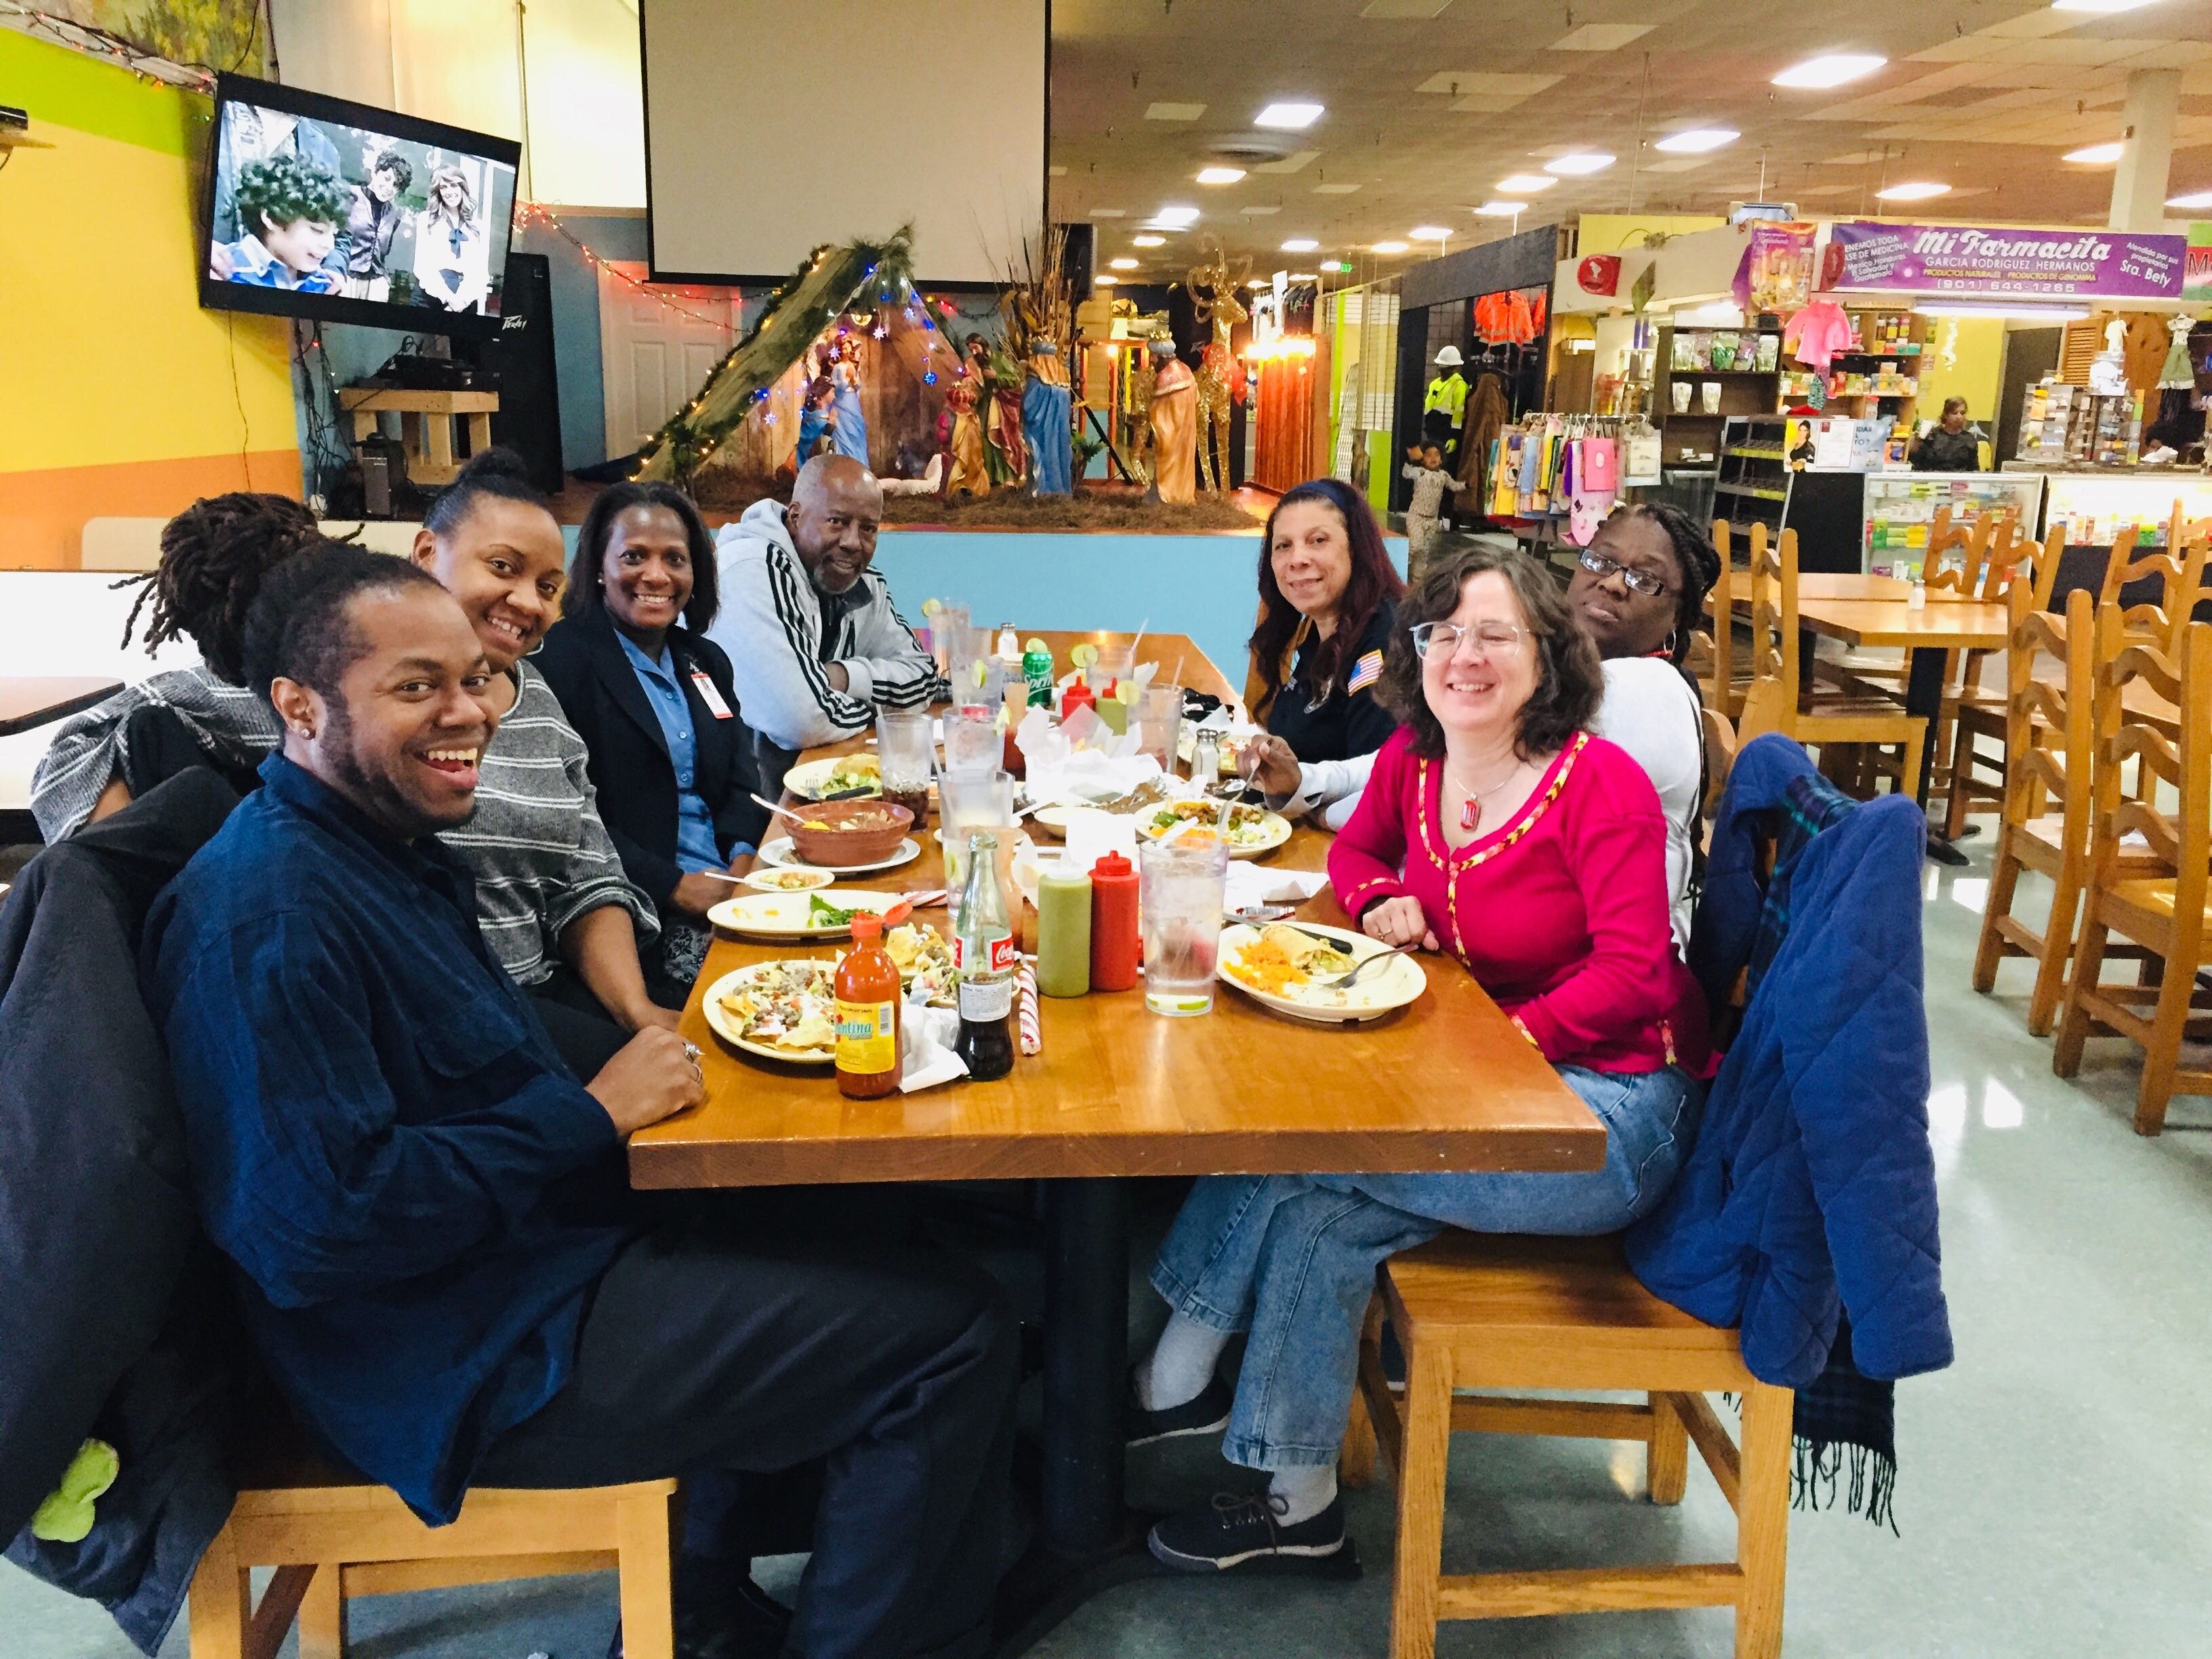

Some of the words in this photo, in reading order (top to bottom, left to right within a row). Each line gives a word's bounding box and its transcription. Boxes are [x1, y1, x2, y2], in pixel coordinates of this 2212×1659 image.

[1844, 239, 1877, 253] ENEMOS
[1877, 234, 1899, 245] TODA
[1913, 231, 1959, 254] Mi
[1959, 230, 2112, 261] Farmacita
[1844, 252, 1857, 262] ASE
[1858, 249, 1869, 259] DE
[1870, 242, 1909, 257] MEDICINA
[2156, 252, 2168, 261] por
[2168, 256, 2179, 265] sus
[1851, 269, 1858, 277] El
[1859, 264, 1889, 275] Salvador
[1889, 262, 1895, 270] y
[1971, 258, 2031, 270] RODRIGUEZ
[2036, 260, 2095, 272] HERMANOS
[1854, 270, 1893, 282] Guatemala
[2119, 259, 2142, 277] Sra.
[2144, 267, 2172, 288] Bety
[1937, 279, 1983, 290] (901)
[1990, 280, 2075, 292] 644-1265
[1024, 672, 1052, 689] Sprit
